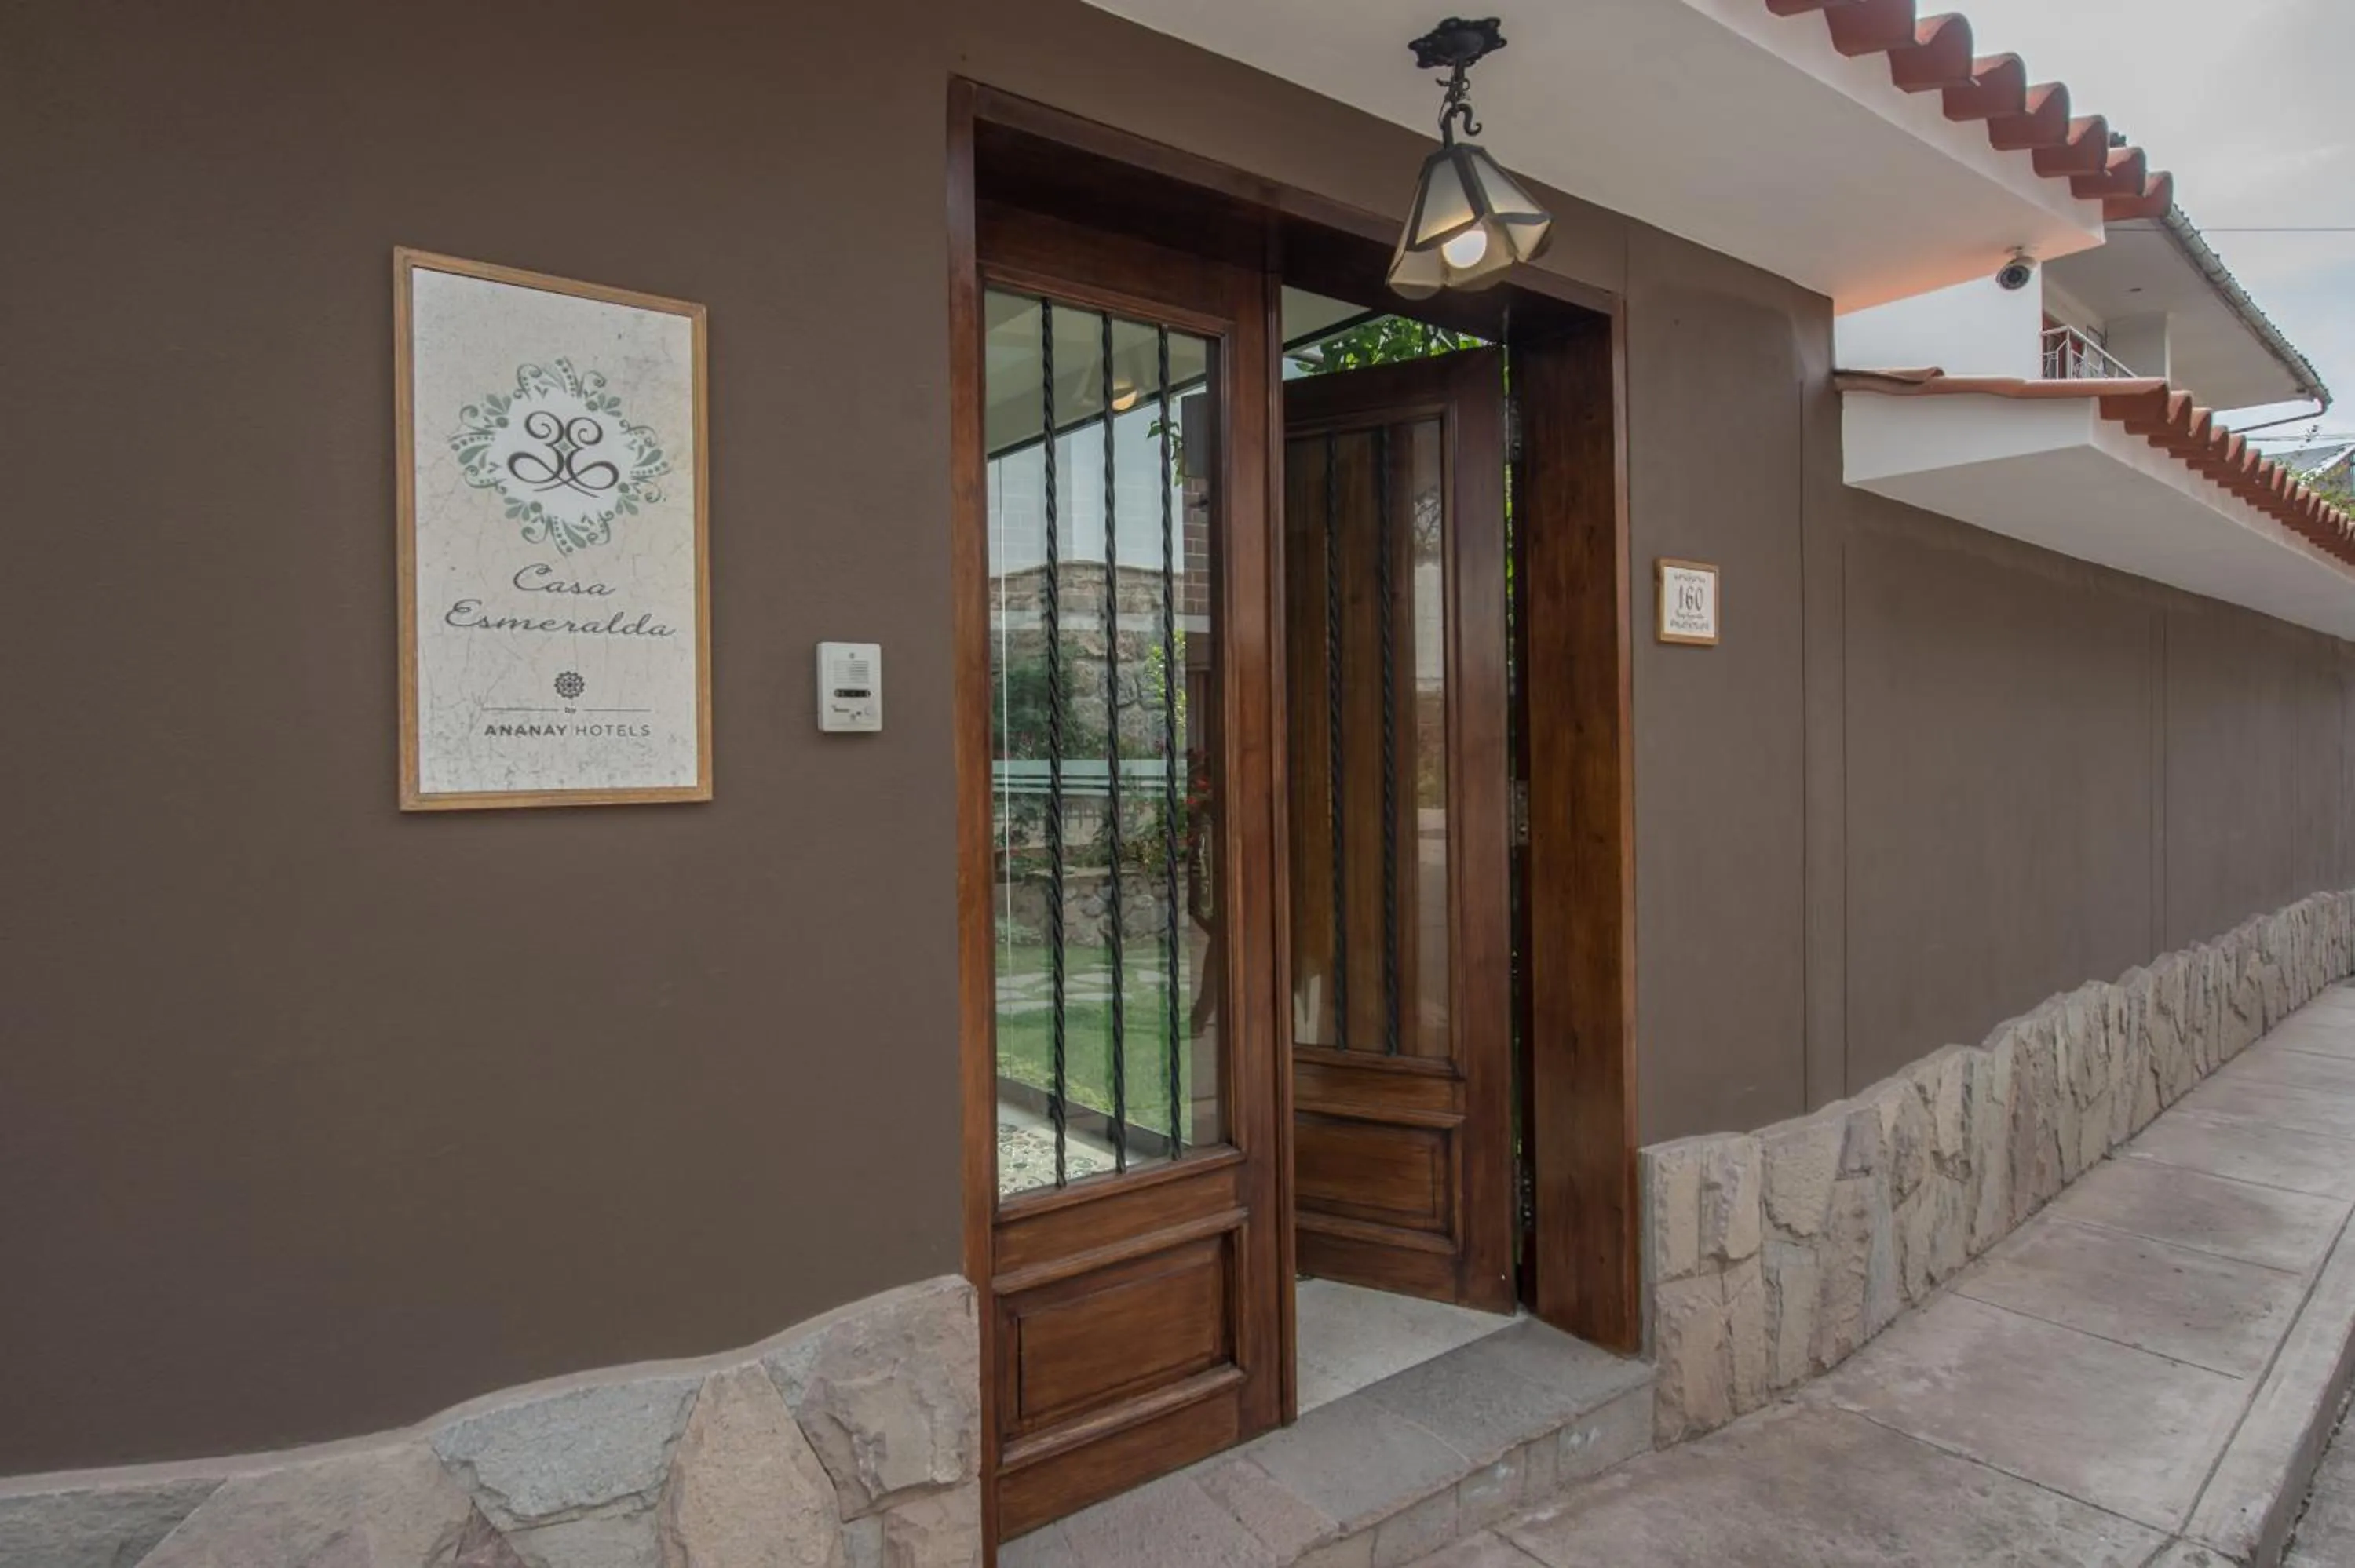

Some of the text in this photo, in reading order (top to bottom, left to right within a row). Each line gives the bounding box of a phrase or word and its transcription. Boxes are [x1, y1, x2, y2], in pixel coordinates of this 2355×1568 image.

[513, 563, 616, 595] Casa
[1679, 584, 1704, 611] 160
[444, 599, 676, 636] Esmeralda
[484, 724, 651, 737] ANANAY HOTELS
